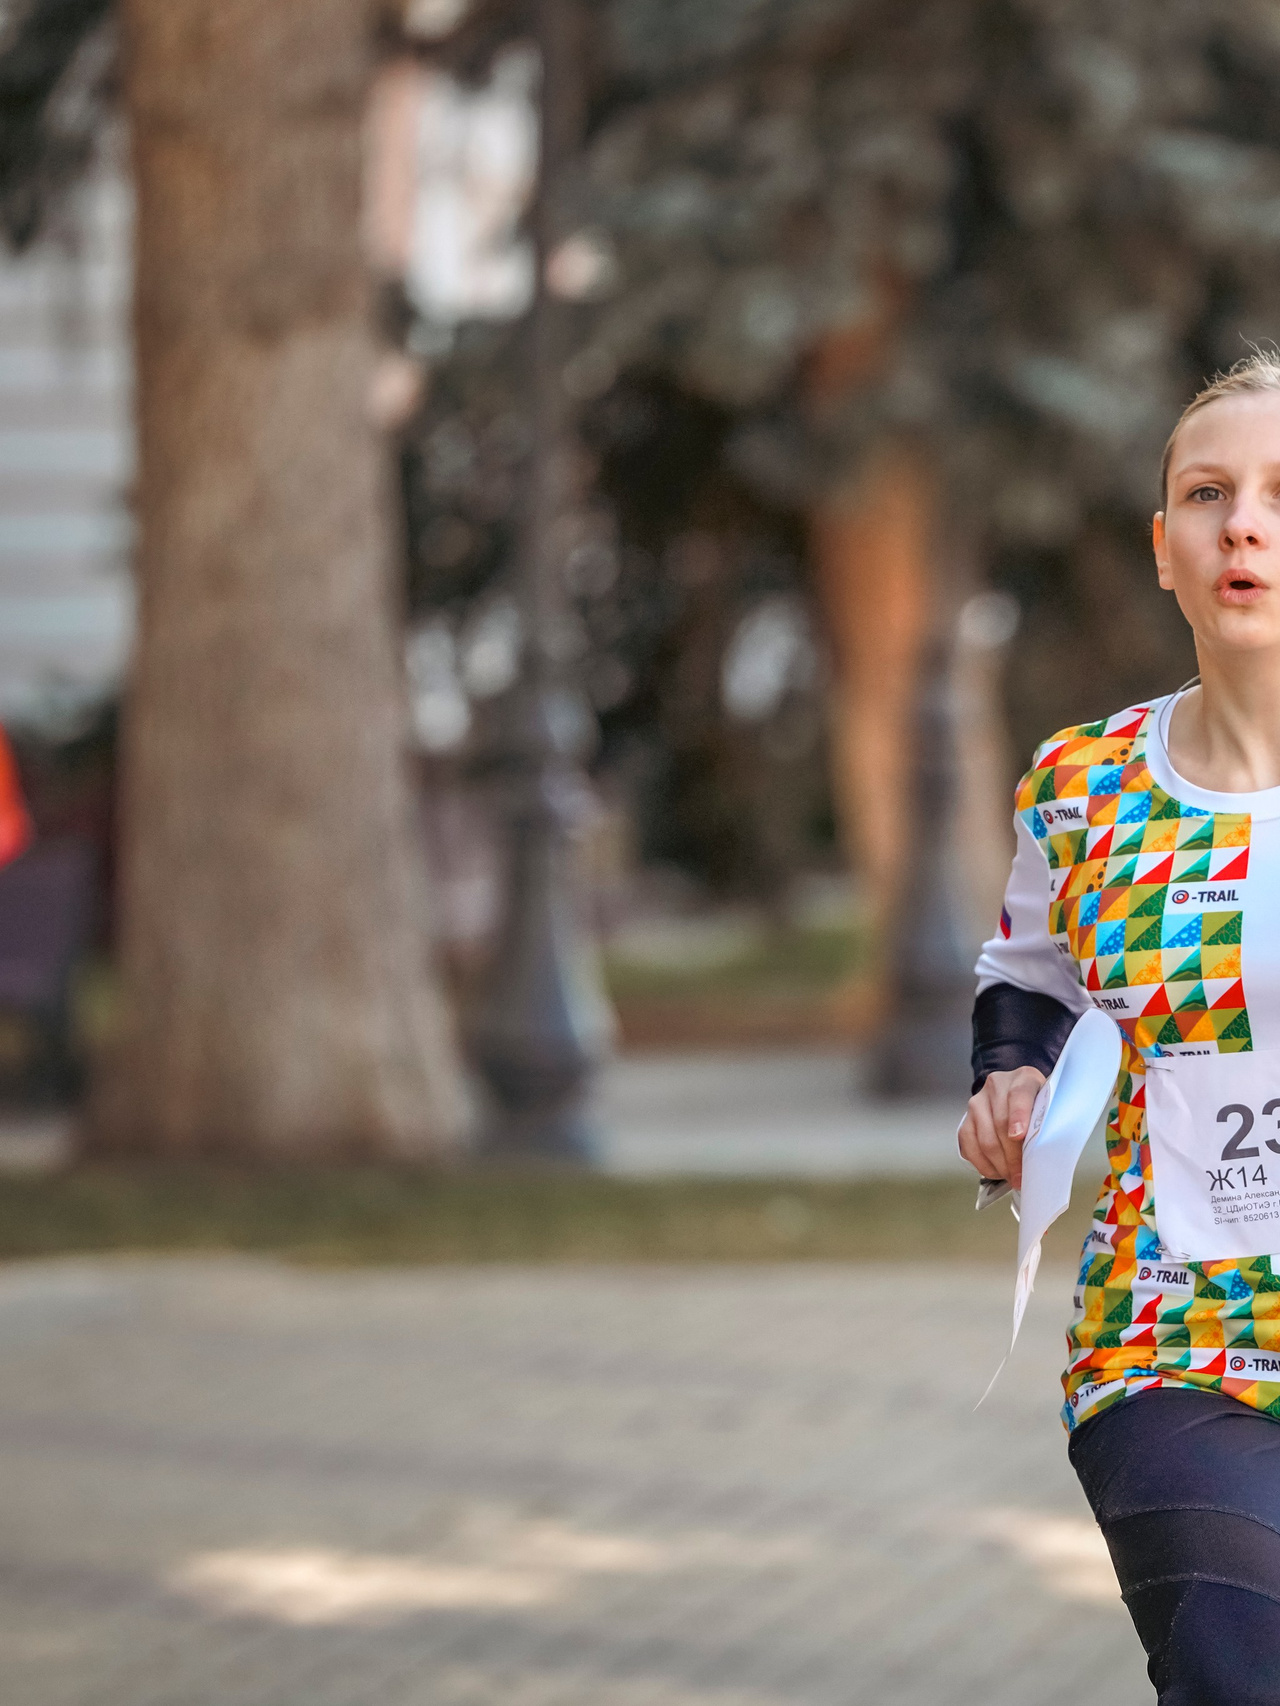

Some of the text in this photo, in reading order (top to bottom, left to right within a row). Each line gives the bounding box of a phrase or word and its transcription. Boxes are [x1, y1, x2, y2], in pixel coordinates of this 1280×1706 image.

[1205, 1164, 1268, 1191] Ж14
[1211, 1195, 1242, 1204] Демина
[1243, 1211, 1280, 1223] 8520613
